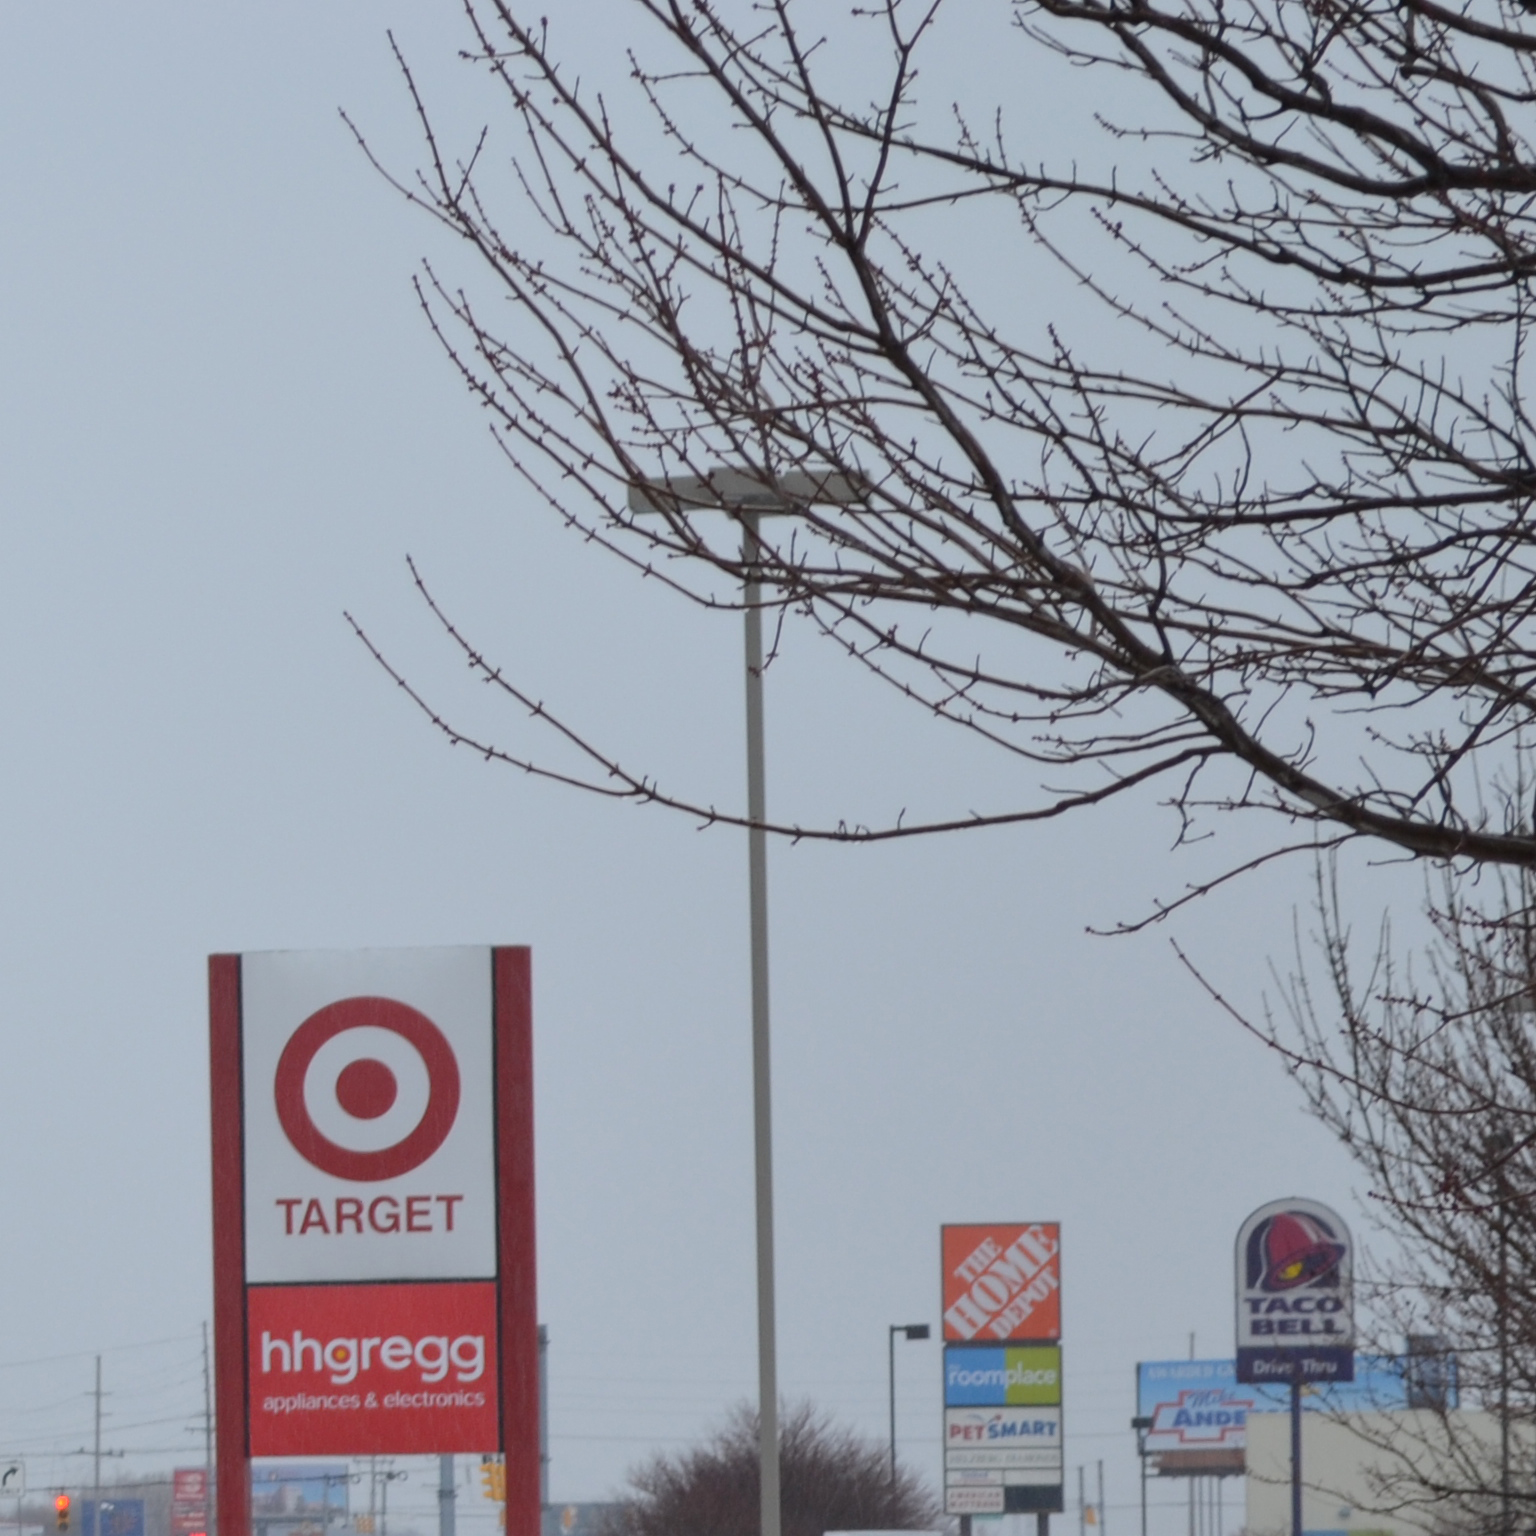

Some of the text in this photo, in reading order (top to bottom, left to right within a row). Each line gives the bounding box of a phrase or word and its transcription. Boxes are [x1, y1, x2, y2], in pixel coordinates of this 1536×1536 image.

[275, 1195, 464, 1235] TARGET
[954, 1237, 1003, 1284] THE
[944, 1224, 1058, 1340] HOME
[989, 1265, 1058, 1339] DEPOT
[1244, 1297, 1344, 1314] TACO
[1250, 1319, 1345, 1335] BELL
[261, 1330, 485, 1385] hhgregg
[1252, 1358, 1295, 1375] Drive
[1301, 1358, 1338, 1375] Thru
[263, 1390, 486, 1413] appliances & electronics
